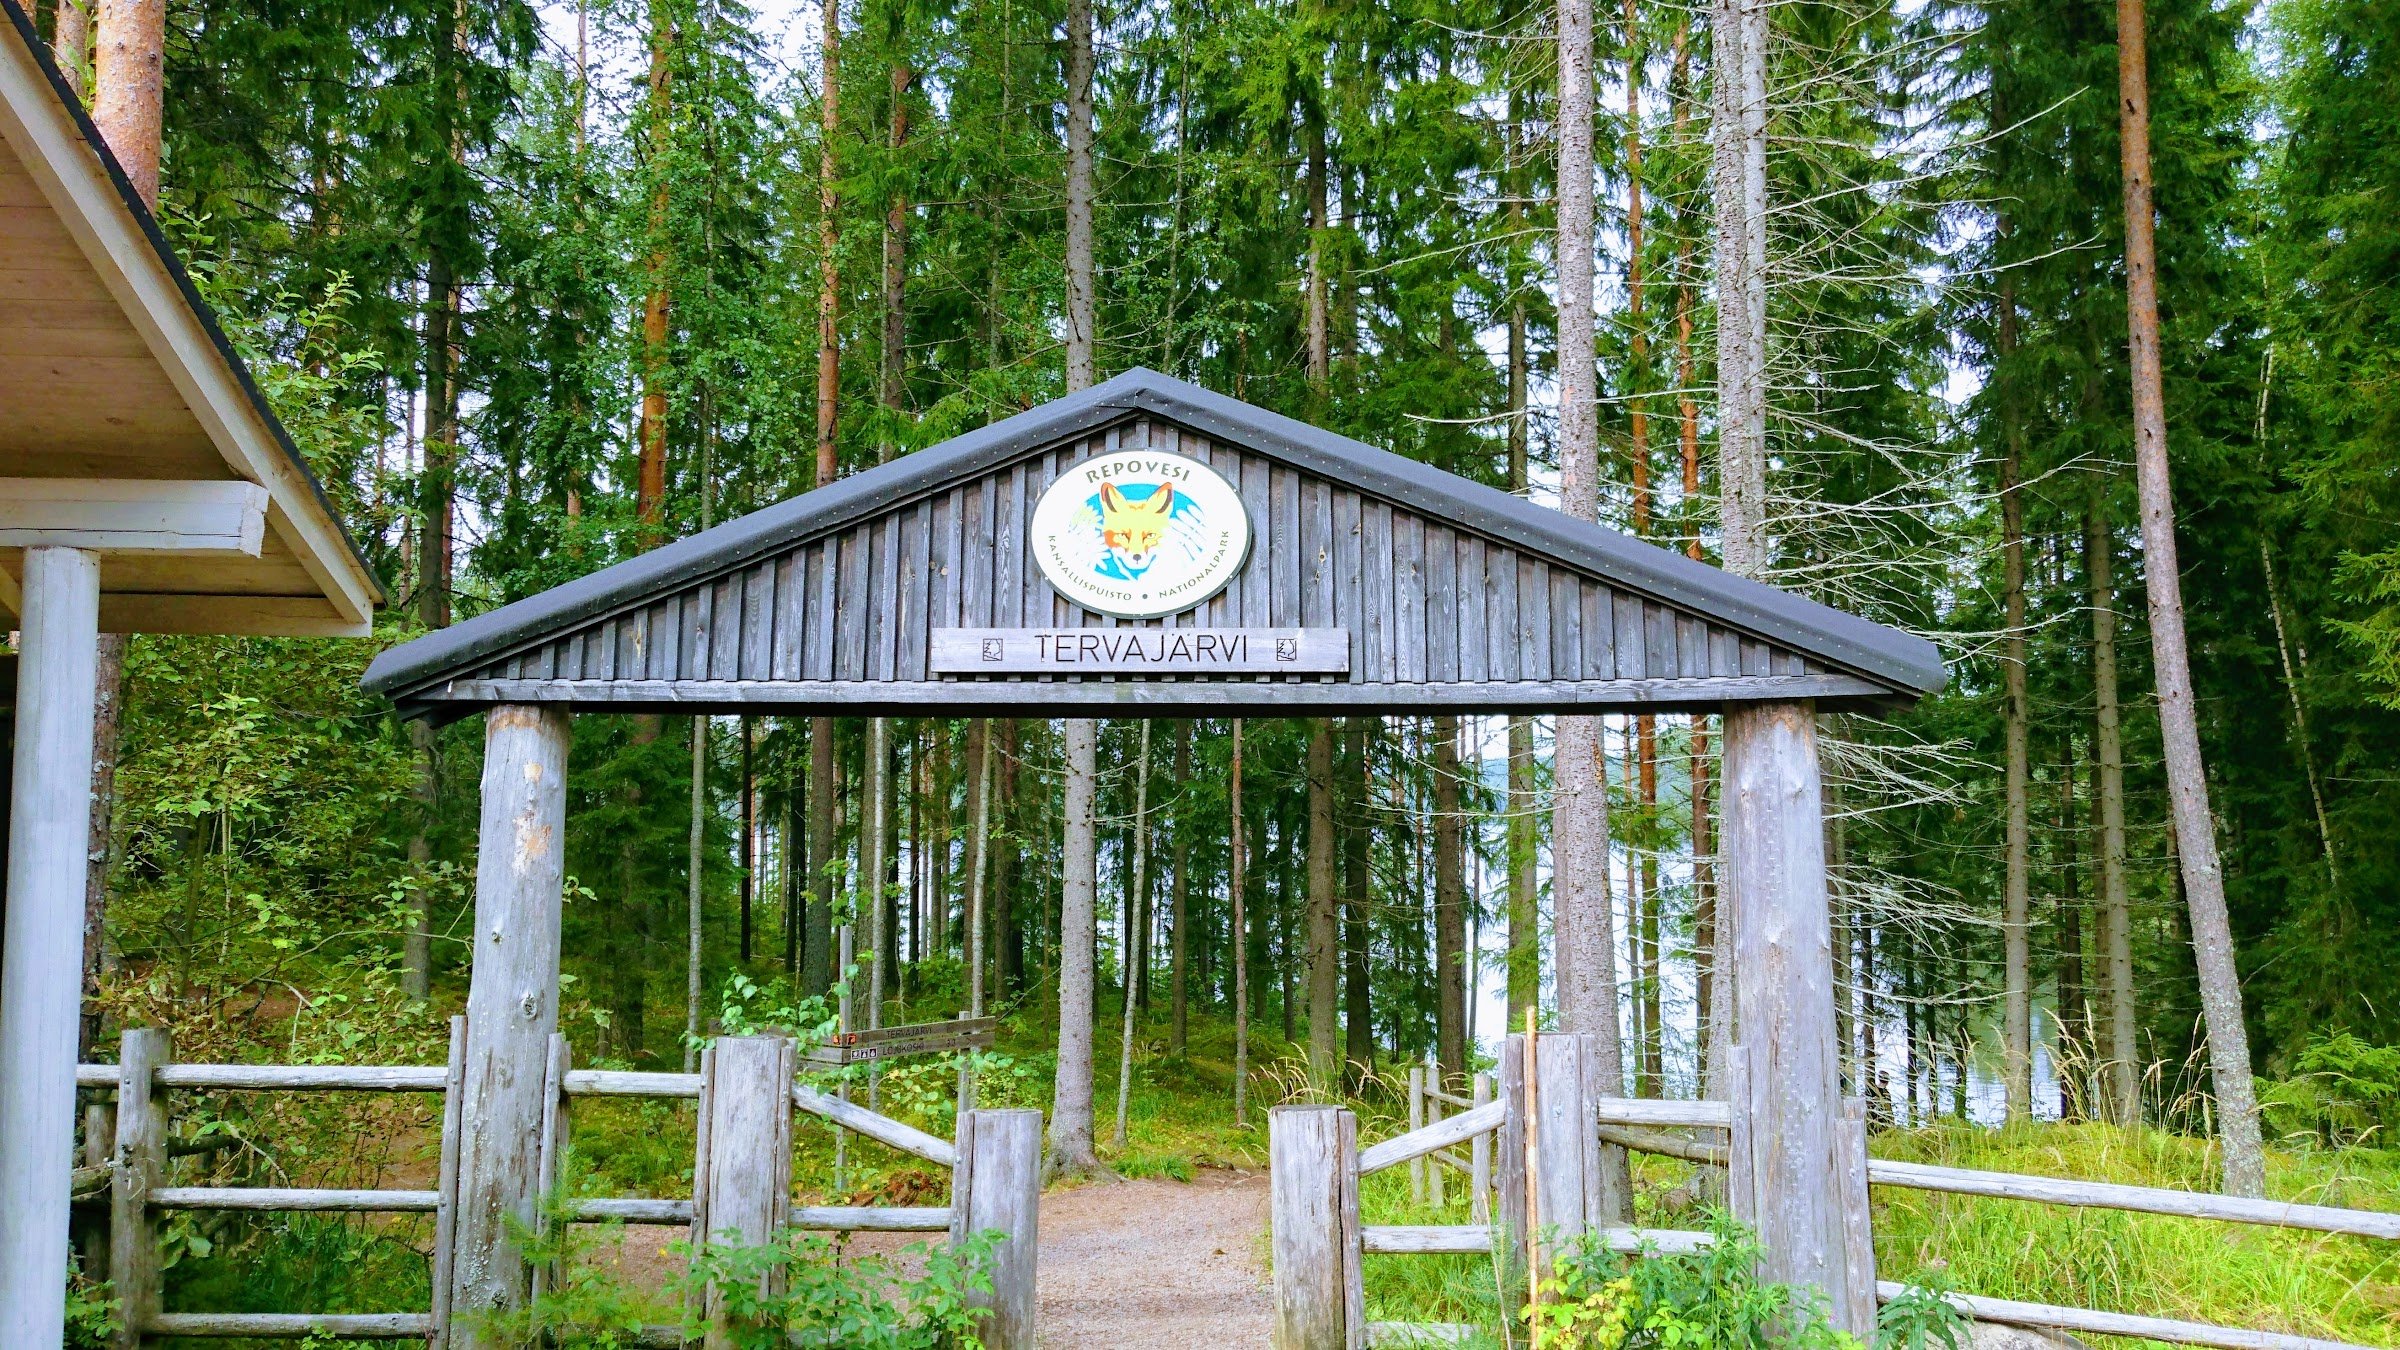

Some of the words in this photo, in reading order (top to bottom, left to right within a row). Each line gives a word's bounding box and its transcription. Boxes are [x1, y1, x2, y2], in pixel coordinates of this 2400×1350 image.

[1085, 460, 1191, 484] REPOVESI
[1048, 535, 1132, 601] KANSALLISPUISTO
[1159, 530, 1230, 599] NATIONALPARK
[1034, 633, 1247, 662] TERVAJÄRVI
